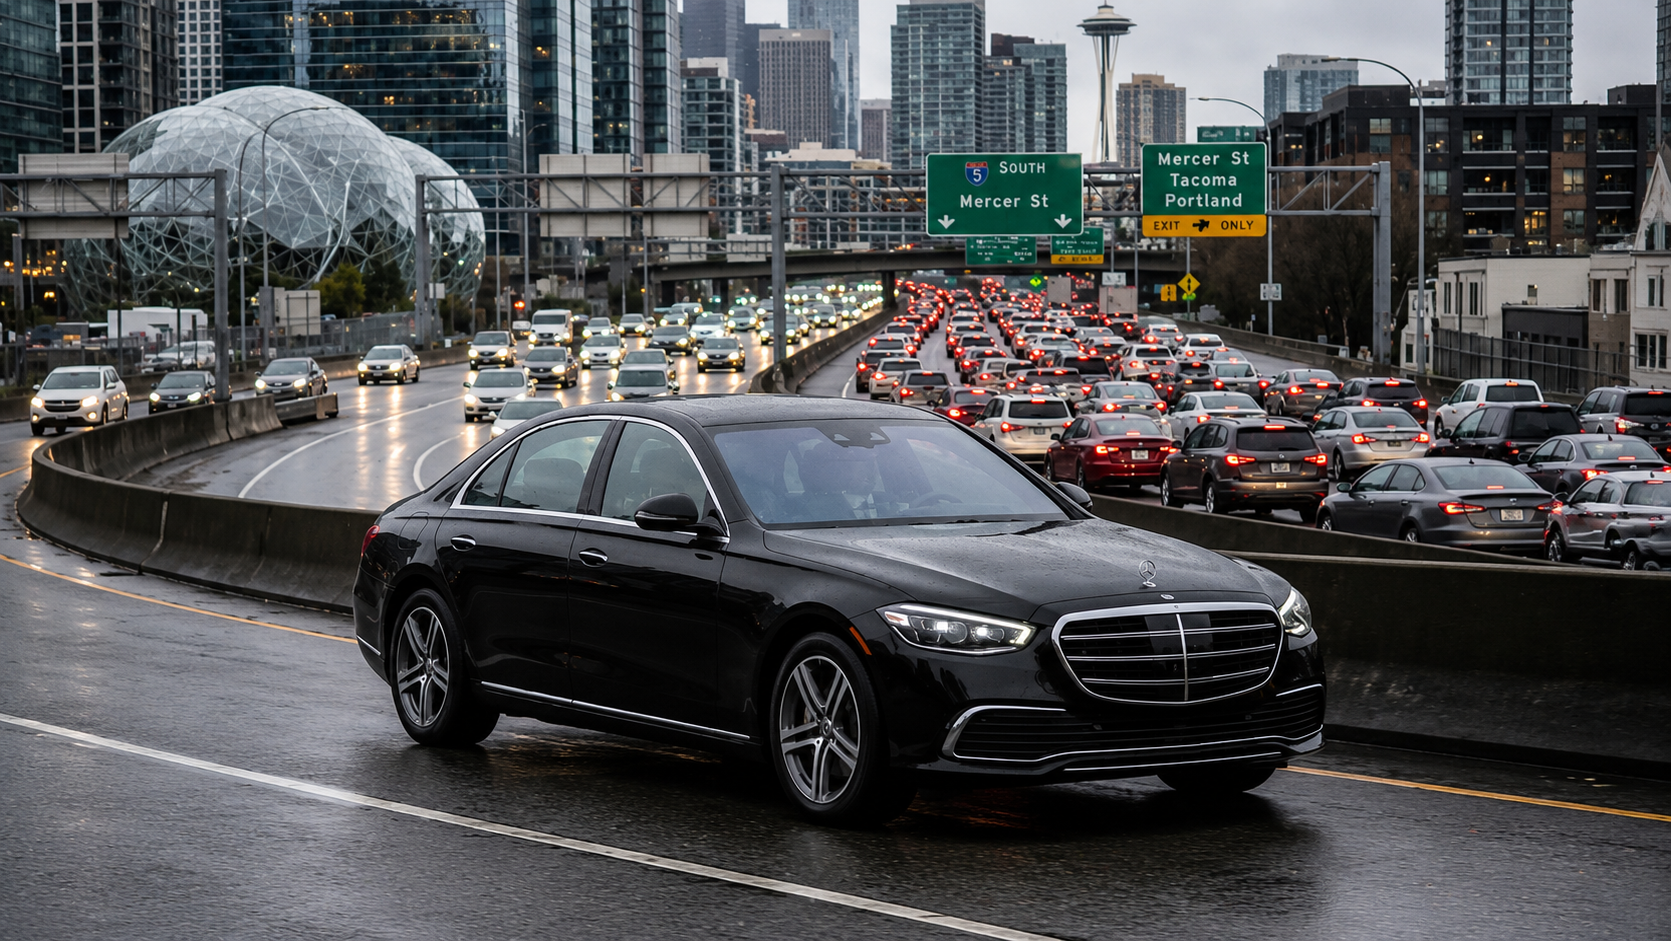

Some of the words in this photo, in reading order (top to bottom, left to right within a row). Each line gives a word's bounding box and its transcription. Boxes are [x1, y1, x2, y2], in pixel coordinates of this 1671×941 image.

[1158, 152, 1220, 166] Mercer
[1231, 151, 1250, 165] St
[973, 168, 982, 183] 5
[999, 161, 1046, 174] SOUTH
[1170, 173, 1237, 187] Tacoma
[960, 194, 1021, 208] Mercer
[1030, 193, 1049, 208] St
[1165, 193, 1242, 208] Portland
[1153, 220, 1180, 231] EXIT
[1220, 220, 1254, 231] ONLY
